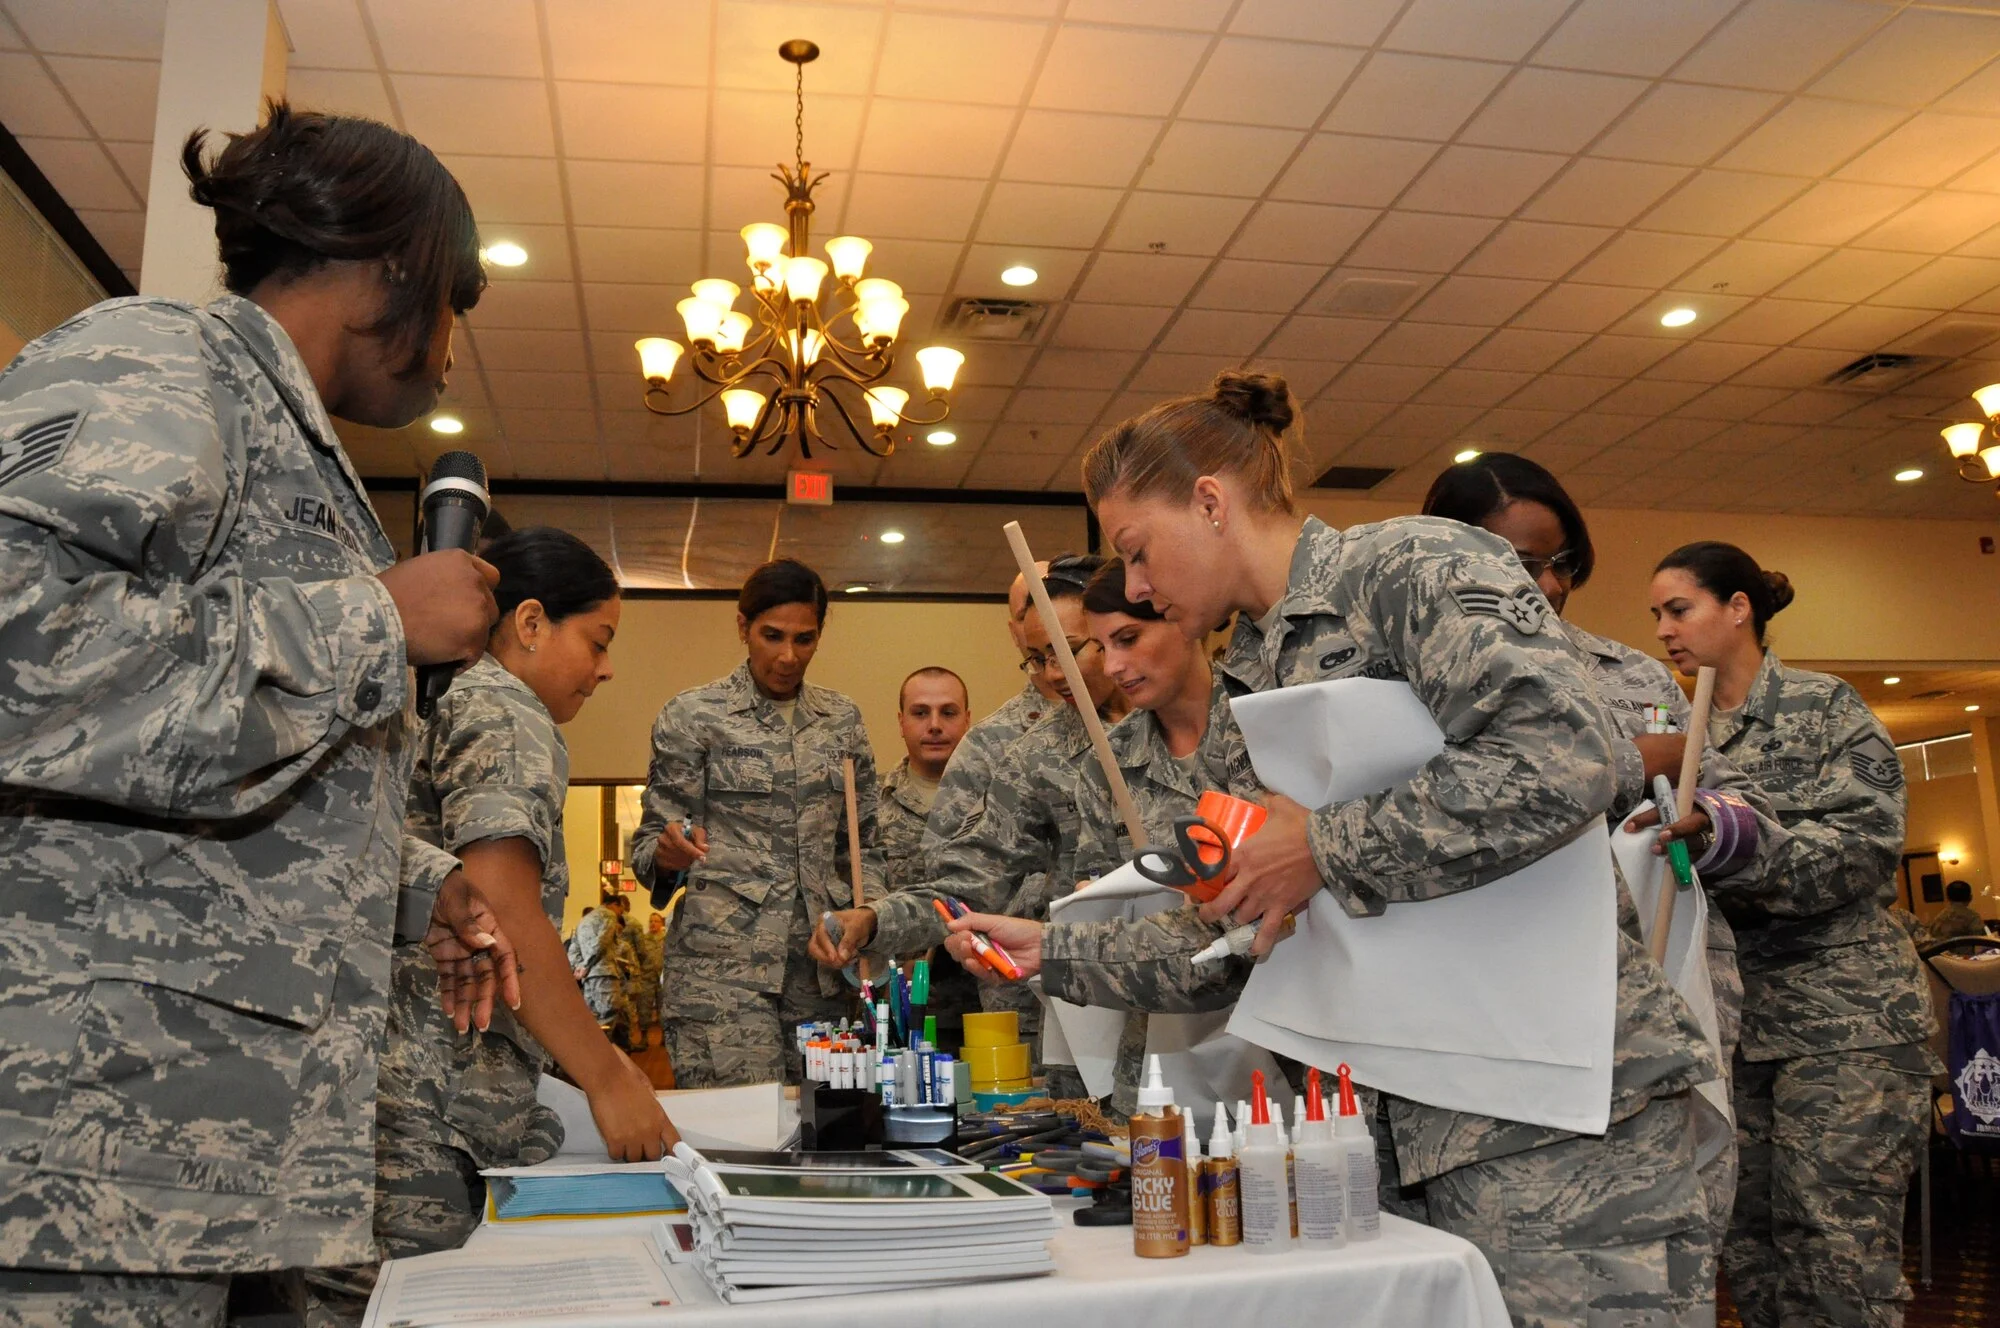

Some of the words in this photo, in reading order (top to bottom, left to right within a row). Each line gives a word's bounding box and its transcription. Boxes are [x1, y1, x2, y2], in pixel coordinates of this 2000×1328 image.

[795, 473, 829, 500] EXIT
[721, 746, 763, 760] PEARSON
[1758, 760, 1772, 773] AIR
[1774, 757, 1803, 771] FORCE
[1132, 1194, 1172, 1212] GLUE
